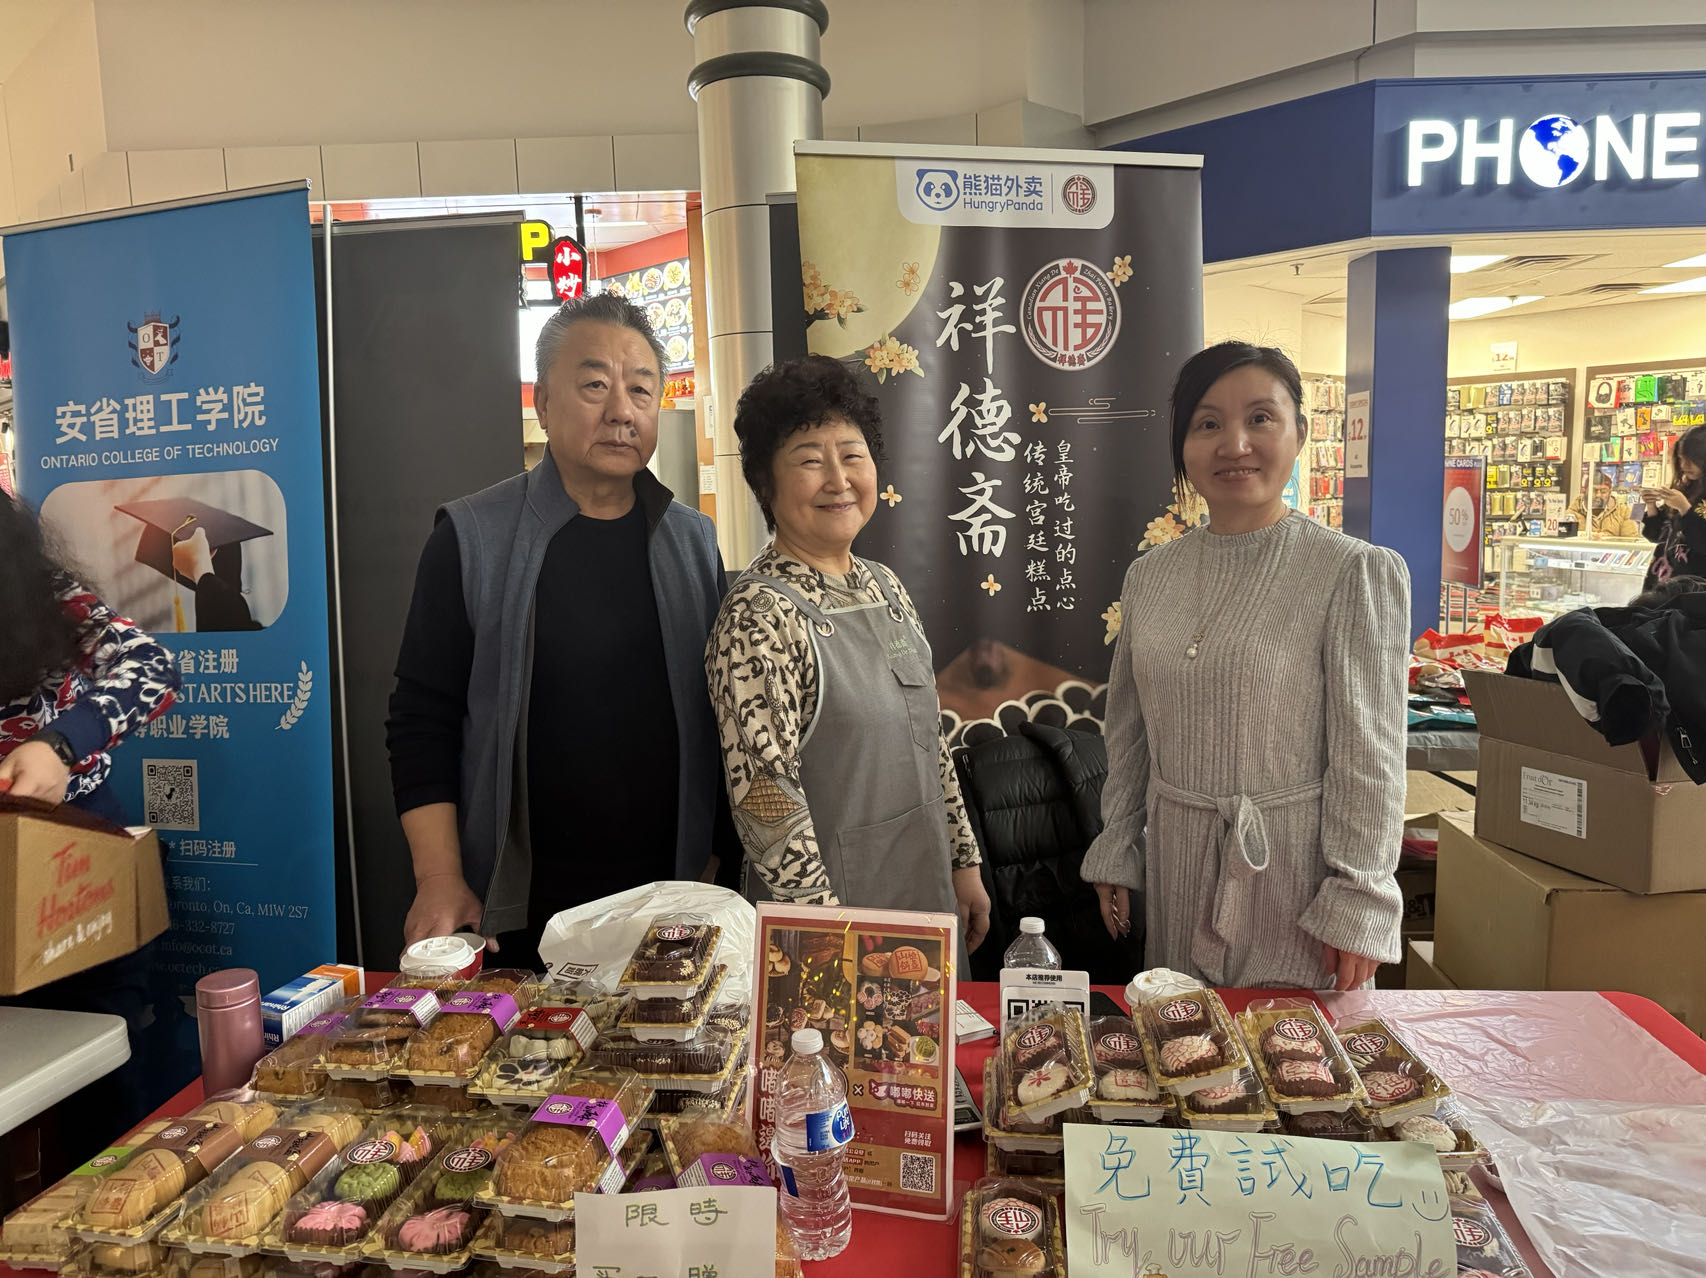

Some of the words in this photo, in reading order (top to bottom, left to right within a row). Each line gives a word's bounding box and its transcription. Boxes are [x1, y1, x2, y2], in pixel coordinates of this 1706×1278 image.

[1407, 112, 1700, 188] PHONE
[963, 173, 1043, 197] 熊猫外卖
[963, 198, 1043, 213] HungryPanda
[556, 247, 582, 298] 小炒
[55, 382, 266, 445] 安省理工学院
[935, 276, 1022, 557] 祥德斋
[40, 453, 98, 470] ONTARIO
[102, 447, 160, 466] COLLEGE
[164, 446, 182, 460] OF
[186, 438, 280, 459] TECHNOLOGY
[1022, 443, 1052, 613] 传统宫廷糕点
[1053, 440, 1077, 610] 皇帝吃过的点心
[249, 683, 294, 703] HERE
[179, 839, 236, 858] 扫码注册
[288, 905, 309, 919] 2S7
[1026, 974, 1063, 982] 本店推荐使用
[889, 1086, 935, 1103] 嘟嘟快送
[1095, 1128, 1403, 1207] 免費試吃
[625, 1198, 728, 1228] 限時
[1248, 1211, 1319, 1278] Free
